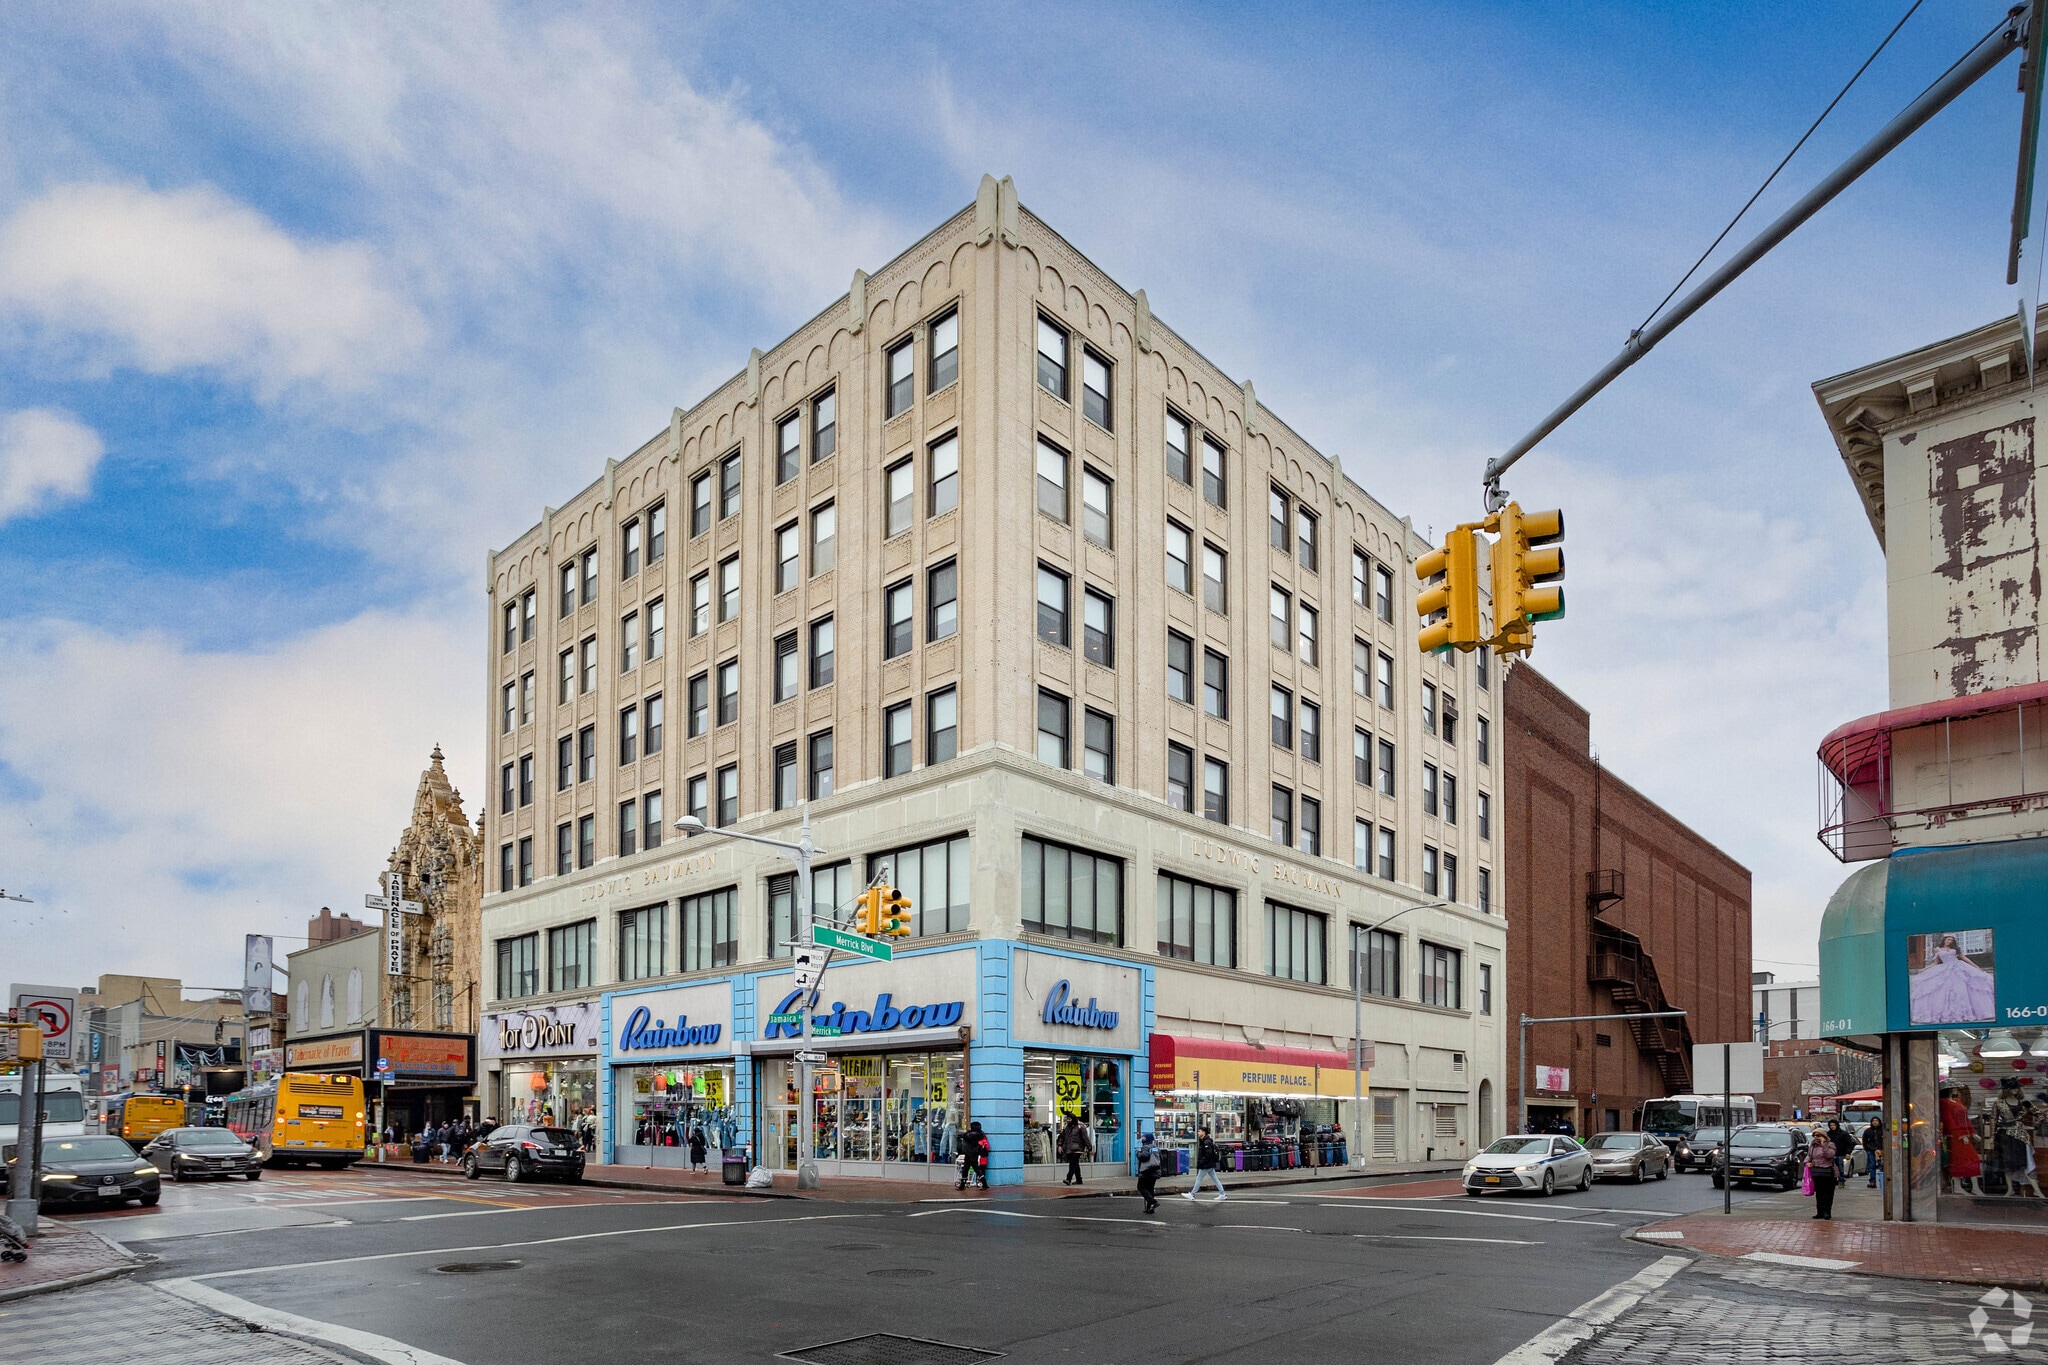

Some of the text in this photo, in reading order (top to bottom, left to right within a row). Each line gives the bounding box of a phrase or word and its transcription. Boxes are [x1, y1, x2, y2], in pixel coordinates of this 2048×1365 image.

[1192, 838, 1342, 898] LUDWIG BAUMANN
[581, 853, 717, 902] LUDWIG BAUMANN
[391, 874, 399, 929] TABERNACLE
[836, 935, 874, 954] Merrick Blvd
[391, 940, 399, 972] PRAYER
[809, 977, 824, 985] LOCL
[1042, 979, 1119, 1029] Rainbow
[2005, 1005, 2048, 1018] 166-0
[770, 1014, 797, 1023] Jamaica
[1822, 1018, 1852, 1032] 166-01
[619, 1005, 722, 1051] Rainbow
[811, 1027, 832, 1036] Merrick
[294, 1047, 321, 1060] Tabernacle
[323, 1044, 331, 1058] of
[332, 1044, 351, 1060] Prayer
[1242, 1072, 1277, 1084] PERFUME
[1280, 1075, 1307, 1086] PALACE
